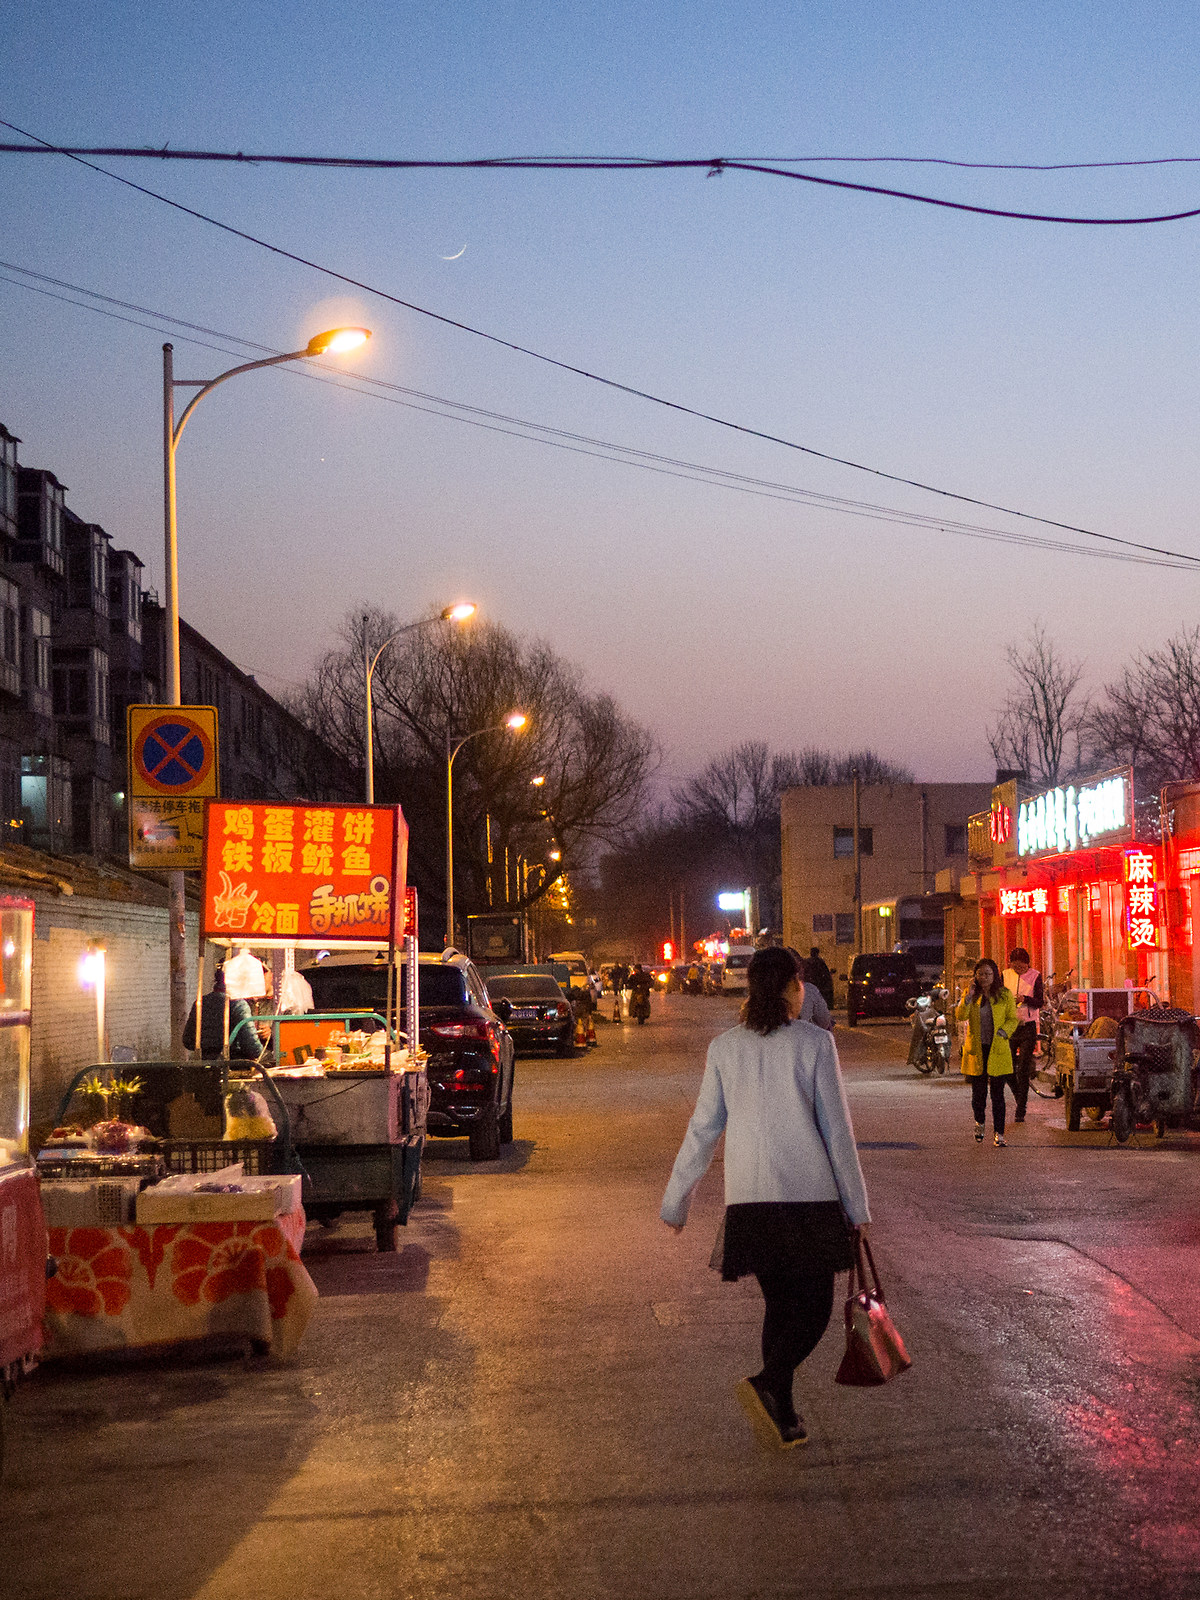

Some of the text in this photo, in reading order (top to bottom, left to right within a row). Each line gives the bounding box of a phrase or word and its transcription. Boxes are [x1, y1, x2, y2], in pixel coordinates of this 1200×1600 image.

[222, 807, 375, 844] 鸡蛋灌饼
[221, 840, 372, 876] 铁板鱿鱼
[309, 874, 391, 934] 手抓饼
[1000, 888, 1049, 915] 烤红薯
[1128, 852, 1156, 948] 麻辣烫
